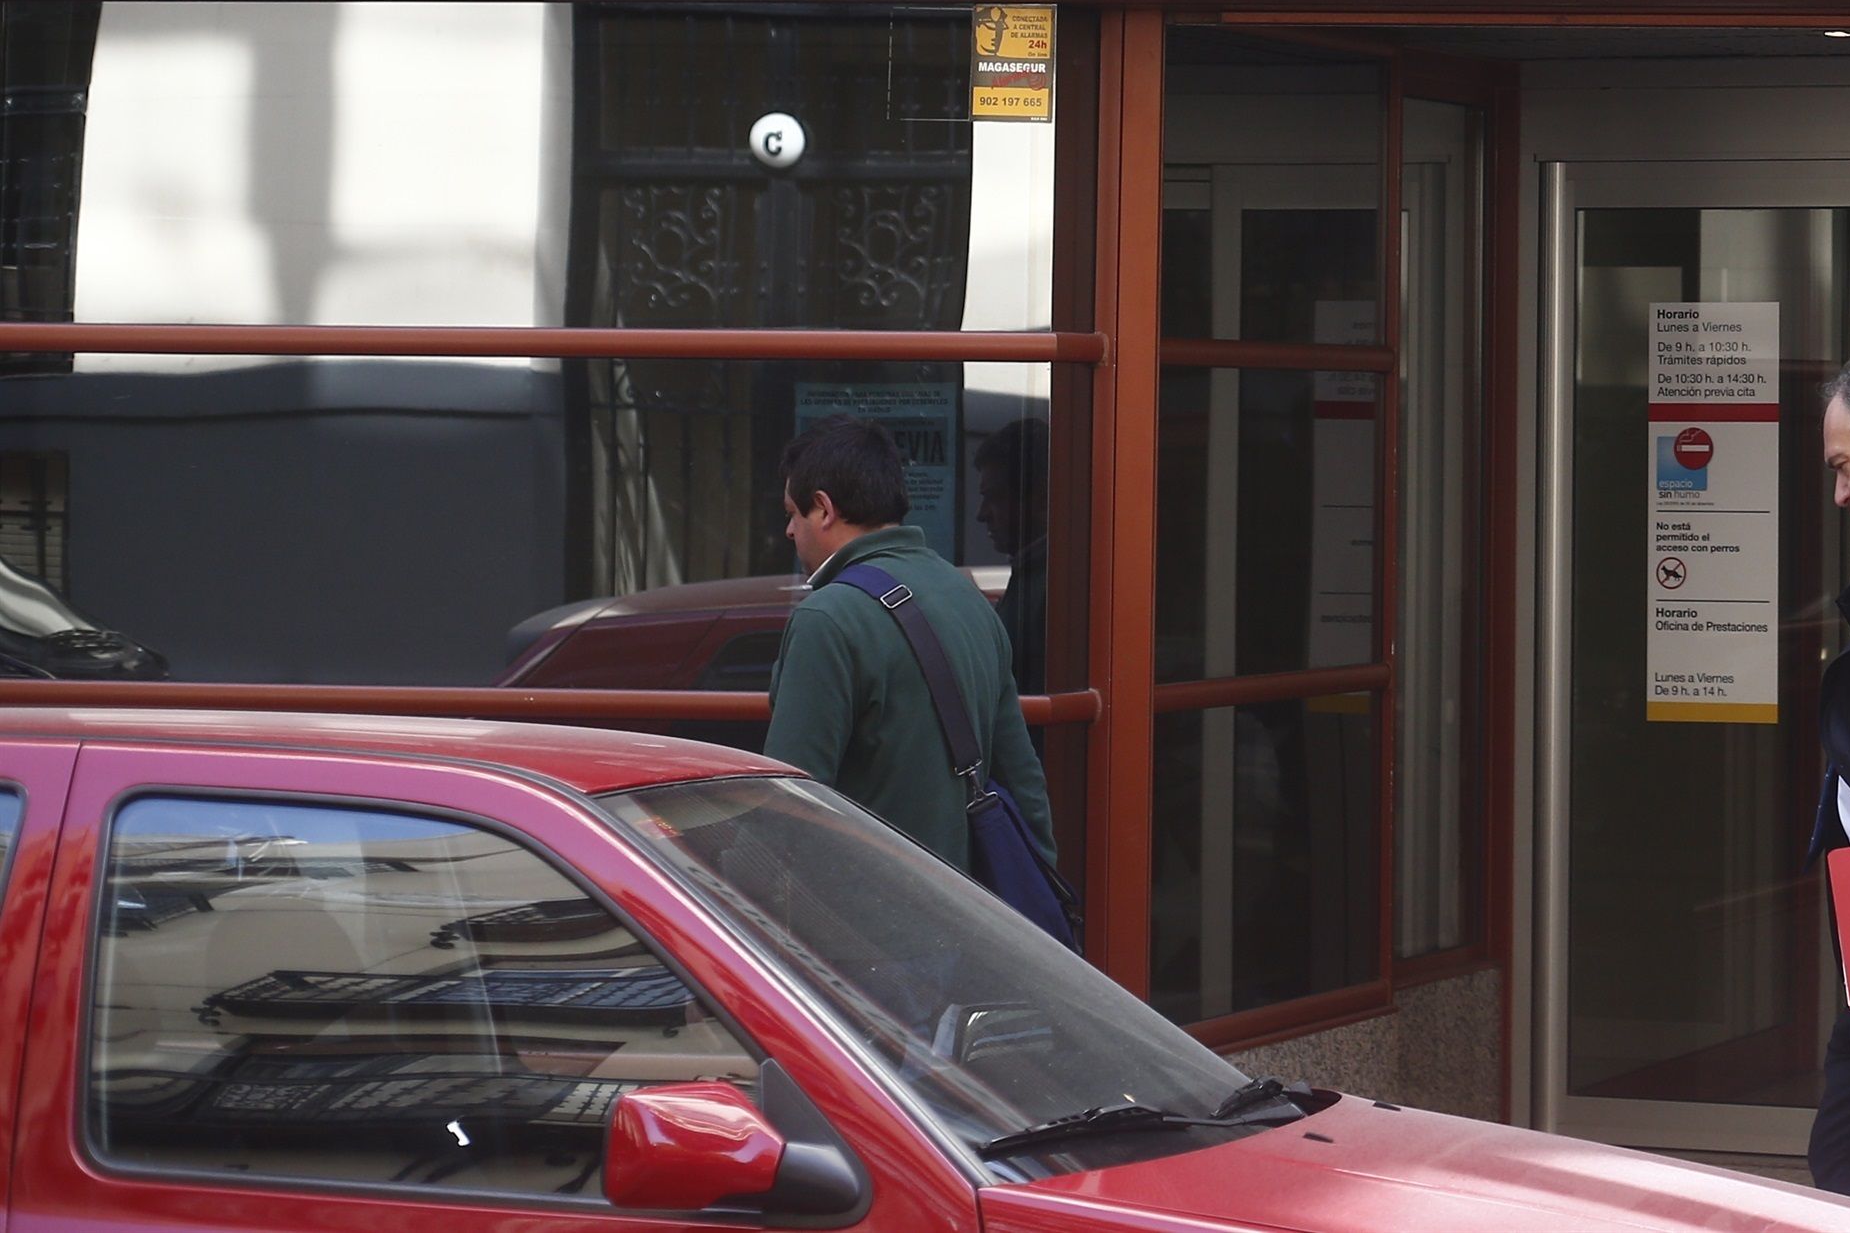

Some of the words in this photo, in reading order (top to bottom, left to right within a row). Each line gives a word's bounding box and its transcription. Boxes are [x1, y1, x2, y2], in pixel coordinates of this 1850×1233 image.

[1028, 40, 1047, 49] 24h
[978, 62, 1047, 73] MAGASEGUR
[979, 97, 999, 106] 902
[1002, 98, 1021, 107] 197
[1023, 98, 1043, 107] 665
[1657, 309, 1700, 319] Horario
[1657, 323, 1690, 333] Lunes
[1692, 325, 1699, 333] a
[1702, 322, 1743, 333] Viernes
[1657, 342, 1673, 352] De
[1675, 342, 1683, 352] 9
[1685, 342, 1696, 353] h.
[1698, 344, 1706, 352] a
[1710, 342, 1739, 352] 10:30
[1741, 342, 1752, 352] h.
[1657, 354, 1703, 366] Trámites
[1706, 355, 1747, 368] rápidos
[1657, 374, 1672, 384] De
[1675, 374, 1703, 384] 10:30
[1705, 374, 1714, 384] h.
[1717, 376, 1724, 384] a
[1727, 374, 1755, 384] 14:30
[1757, 374, 1767, 384] h.
[1657, 386, 1702, 397] Atención
[1704, 387, 1735, 399] previa
[1737, 388, 1756, 397] cita
[1658, 479, 1693, 489] espacio
[1656, 522, 1669, 531] No
[1671, 522, 1691, 531] está
[1656, 533, 1700, 542] permitido
[1702, 534, 1710, 542] el
[1710, 545, 1740, 553] perros
[1655, 607, 1698, 618] Horario
[1655, 620, 1690, 631] Oficina
[1691, 621, 1704, 632] de
[1706, 621, 1769, 633] Prestaciones
[1654, 672, 1686, 683] Lunes
[1687, 675, 1695, 683] a
[1696, 672, 1735, 684] Viernes
[1654, 685, 1669, 696] De
[1671, 685, 1679, 696] 9
[1681, 686, 1690, 696] h.
[1693, 688, 1700, 696] a
[1703, 686, 1715, 697] 14
[1717, 686, 1728, 697] h.
